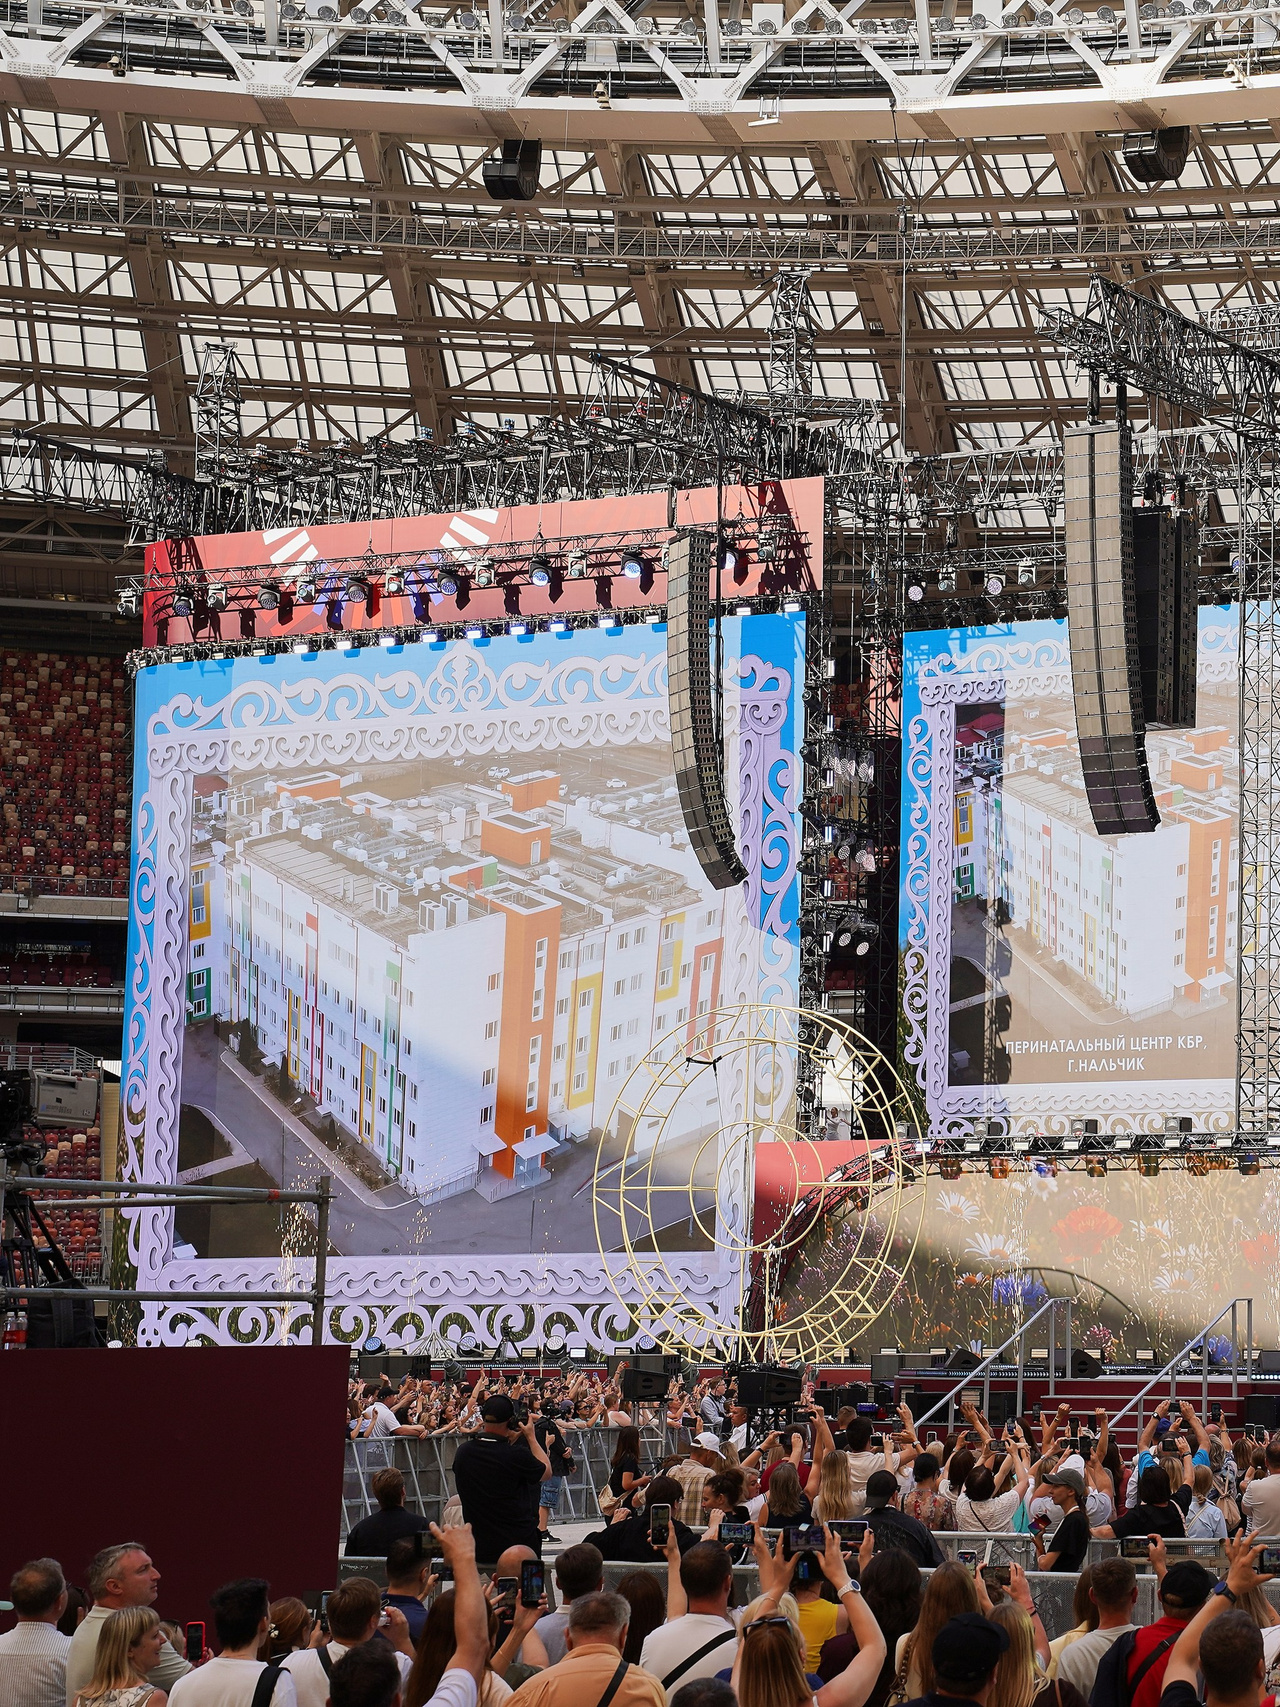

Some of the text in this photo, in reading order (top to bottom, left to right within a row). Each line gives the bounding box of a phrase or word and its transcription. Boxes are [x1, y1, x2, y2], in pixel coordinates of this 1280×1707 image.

[1005, 1034, 1207, 1055] ПЕРИНАТАЛЬНЫЙ ЦЕНТР КБР,
[1067, 1057, 1145, 1072] Г.НАЛЬЧИК
